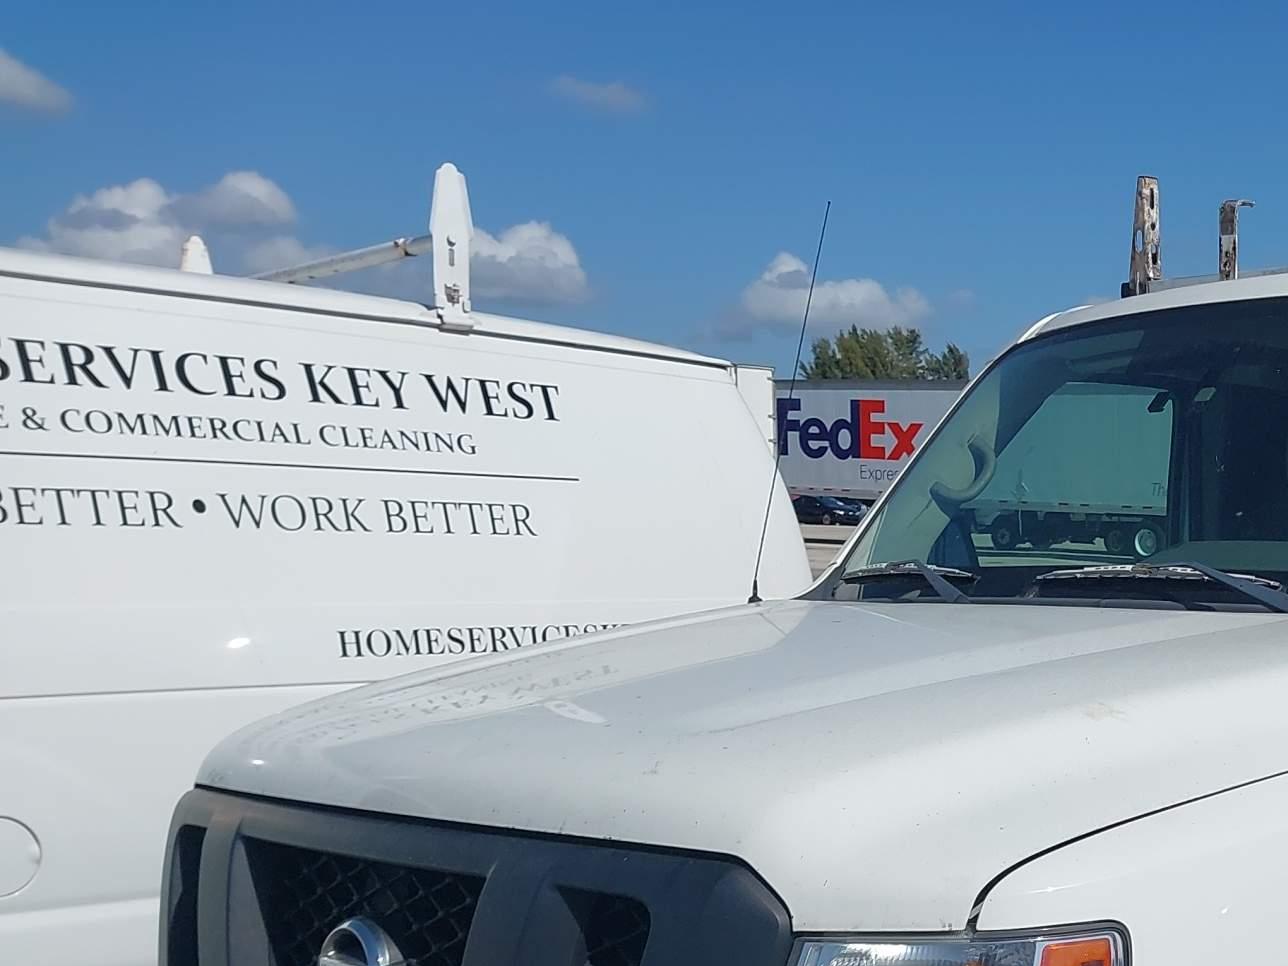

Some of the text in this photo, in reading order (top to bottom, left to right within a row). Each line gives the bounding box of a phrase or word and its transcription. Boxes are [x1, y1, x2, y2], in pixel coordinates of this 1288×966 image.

[298, 361, 408, 410] KEY
[420, 373, 560, 422] WEST
[21, 406, 50, 431] &
[59, 408, 311, 446] COMMERCIAL
[318, 424, 478, 456] CLEANING
[776, 398, 924, 461] FedEx
[216, 493, 373, 533] WORK
[380, 499, 538, 537] BETTER
